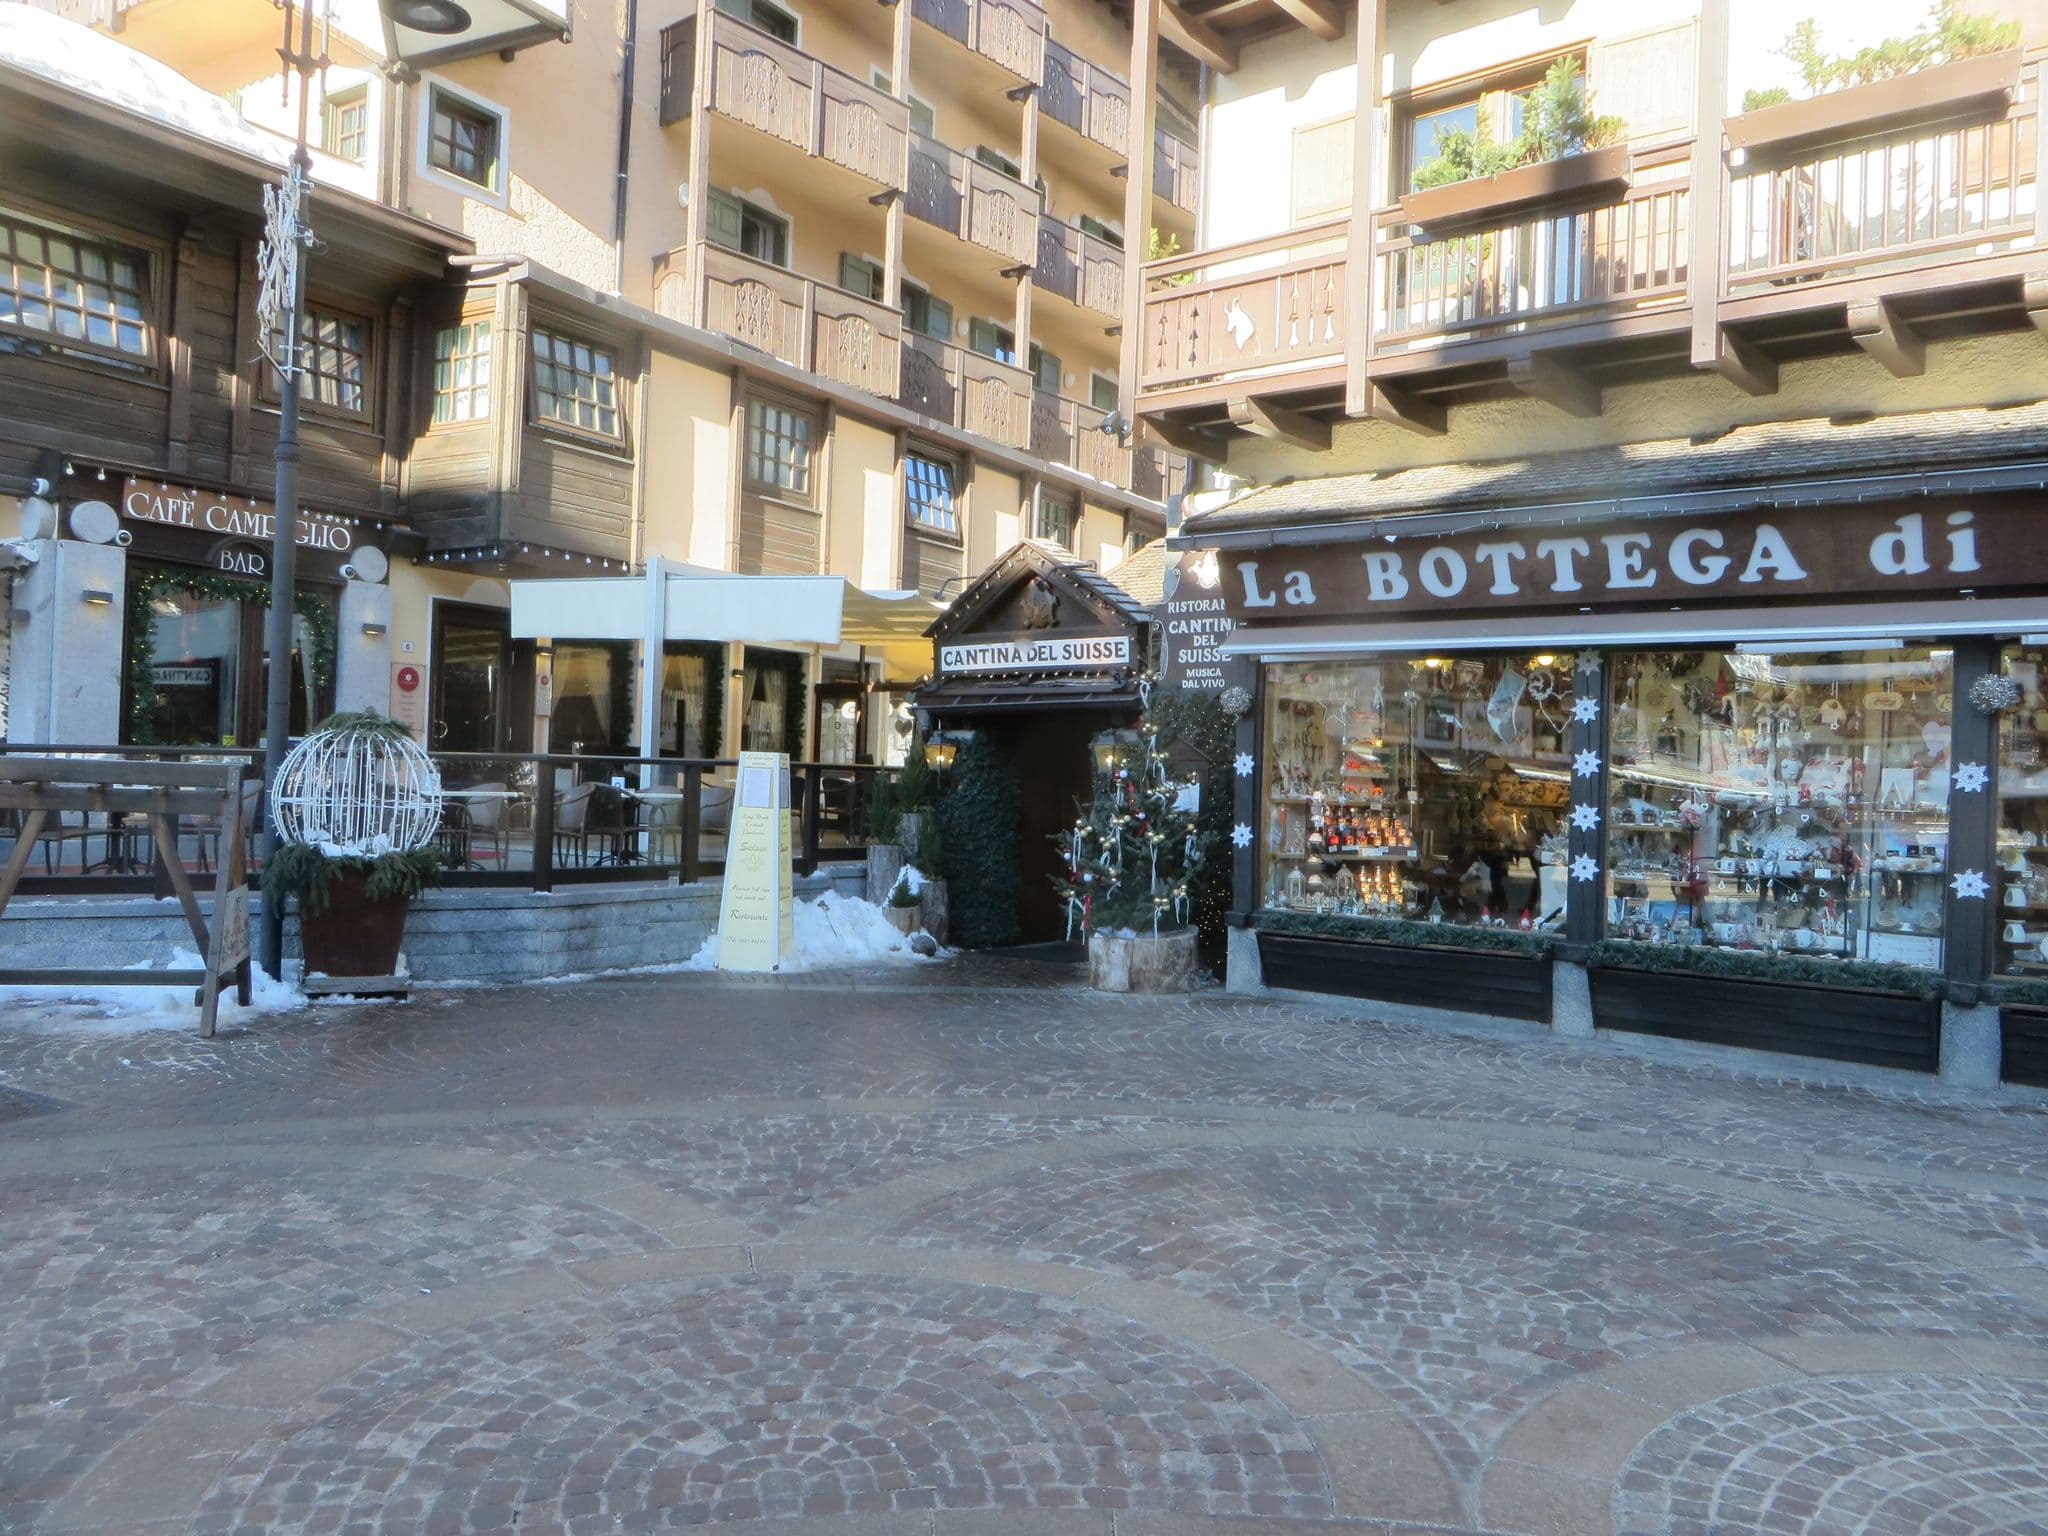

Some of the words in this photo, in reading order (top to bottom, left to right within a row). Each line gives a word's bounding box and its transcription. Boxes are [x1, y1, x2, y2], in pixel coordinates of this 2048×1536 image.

[206, 506, 351, 551] CAMPGLIO
[218, 551, 265, 576] BAR
[1236, 562, 1316, 609] La
[1361, 524, 1807, 602] BOTTEGA
[1869, 510, 1982, 576] di
[1168, 617, 1236, 634] CANTIN
[1193, 634, 1218, 647] DEL
[943, 646, 1023, 667] CANTINA
[1027, 644, 1058, 662] DEL
[1062, 641, 1126, 661] SUISSE
[1178, 648, 1232, 664] SUISSE
[1186, 667, 1222, 678] MUSICA
[1182, 680, 1200, 689] DAL
[1201, 679, 1225, 689] VIVO
